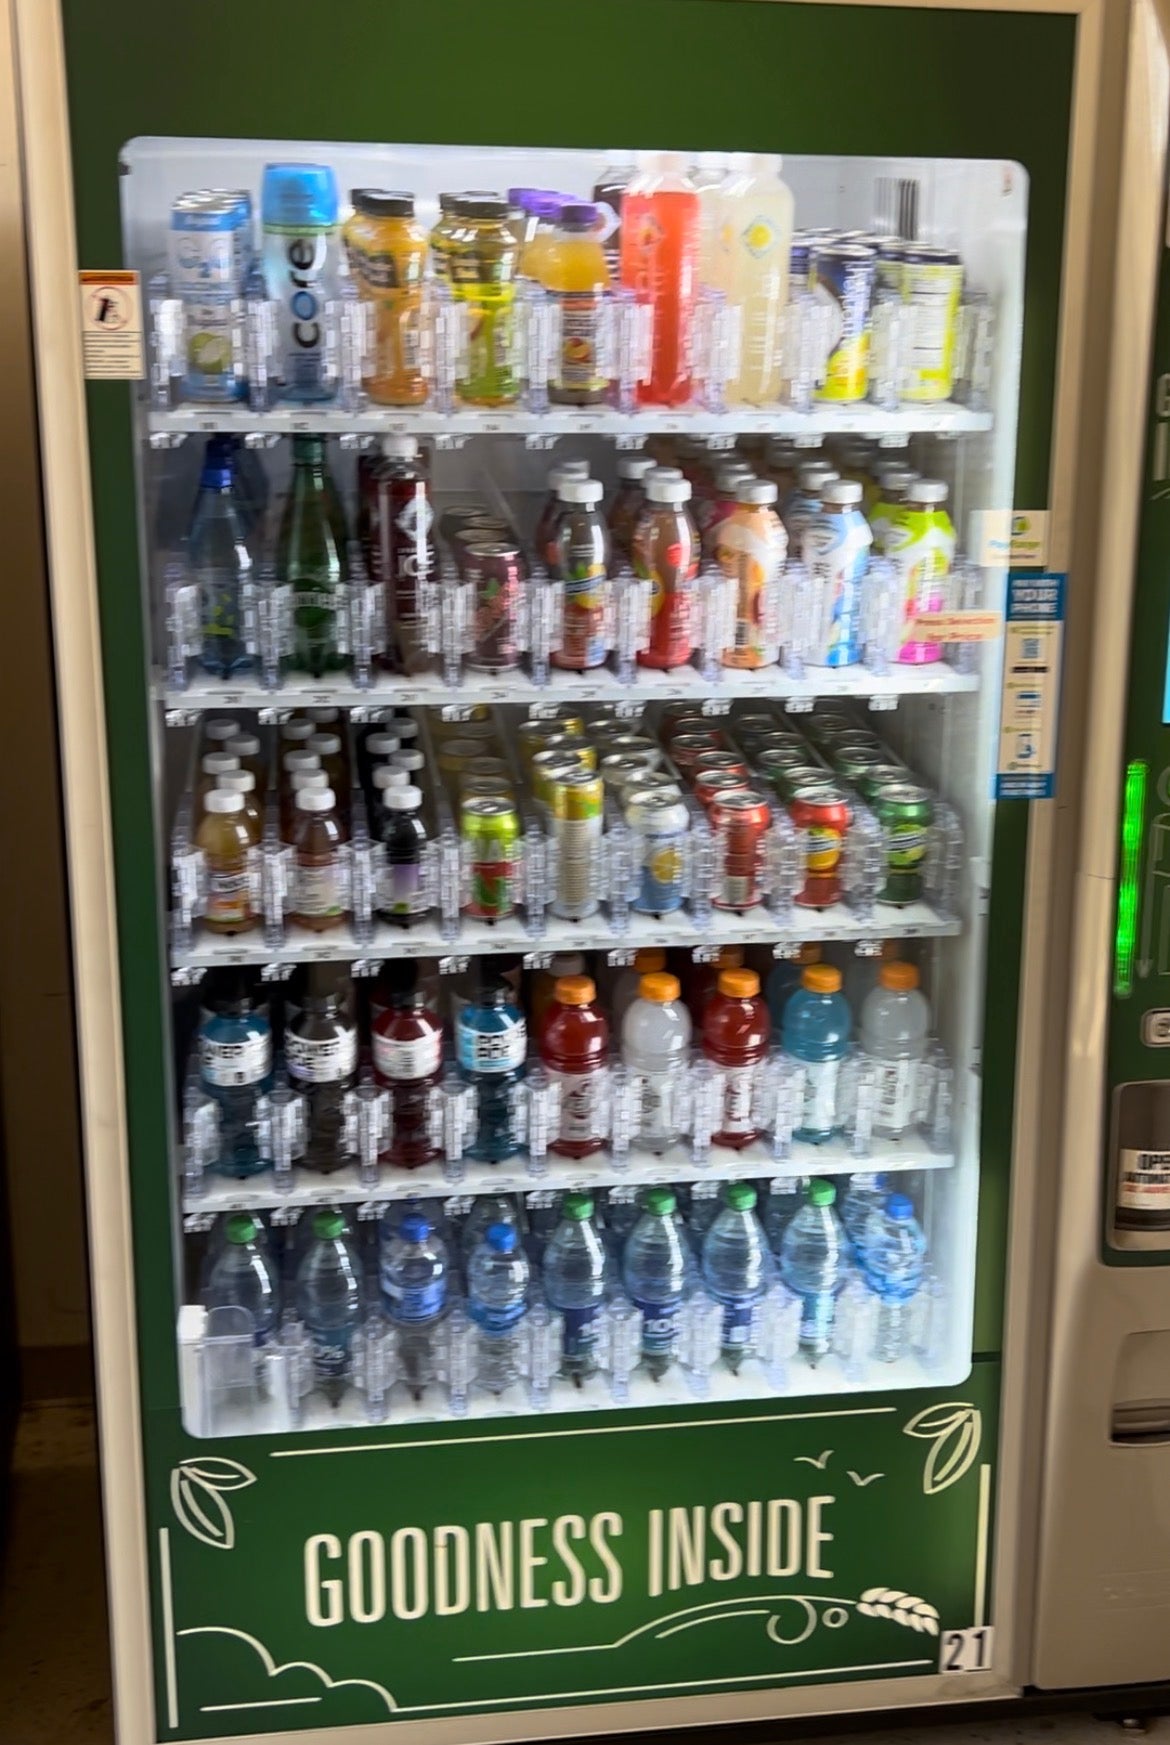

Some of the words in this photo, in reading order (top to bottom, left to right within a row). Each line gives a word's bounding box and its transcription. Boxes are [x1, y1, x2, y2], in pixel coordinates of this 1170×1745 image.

[287, 238, 321, 348] core
[303, 1510, 624, 1627] GOODNESS
[648, 1494, 837, 1598] INSIDE
[945, 1630, 987, 1671] 21
